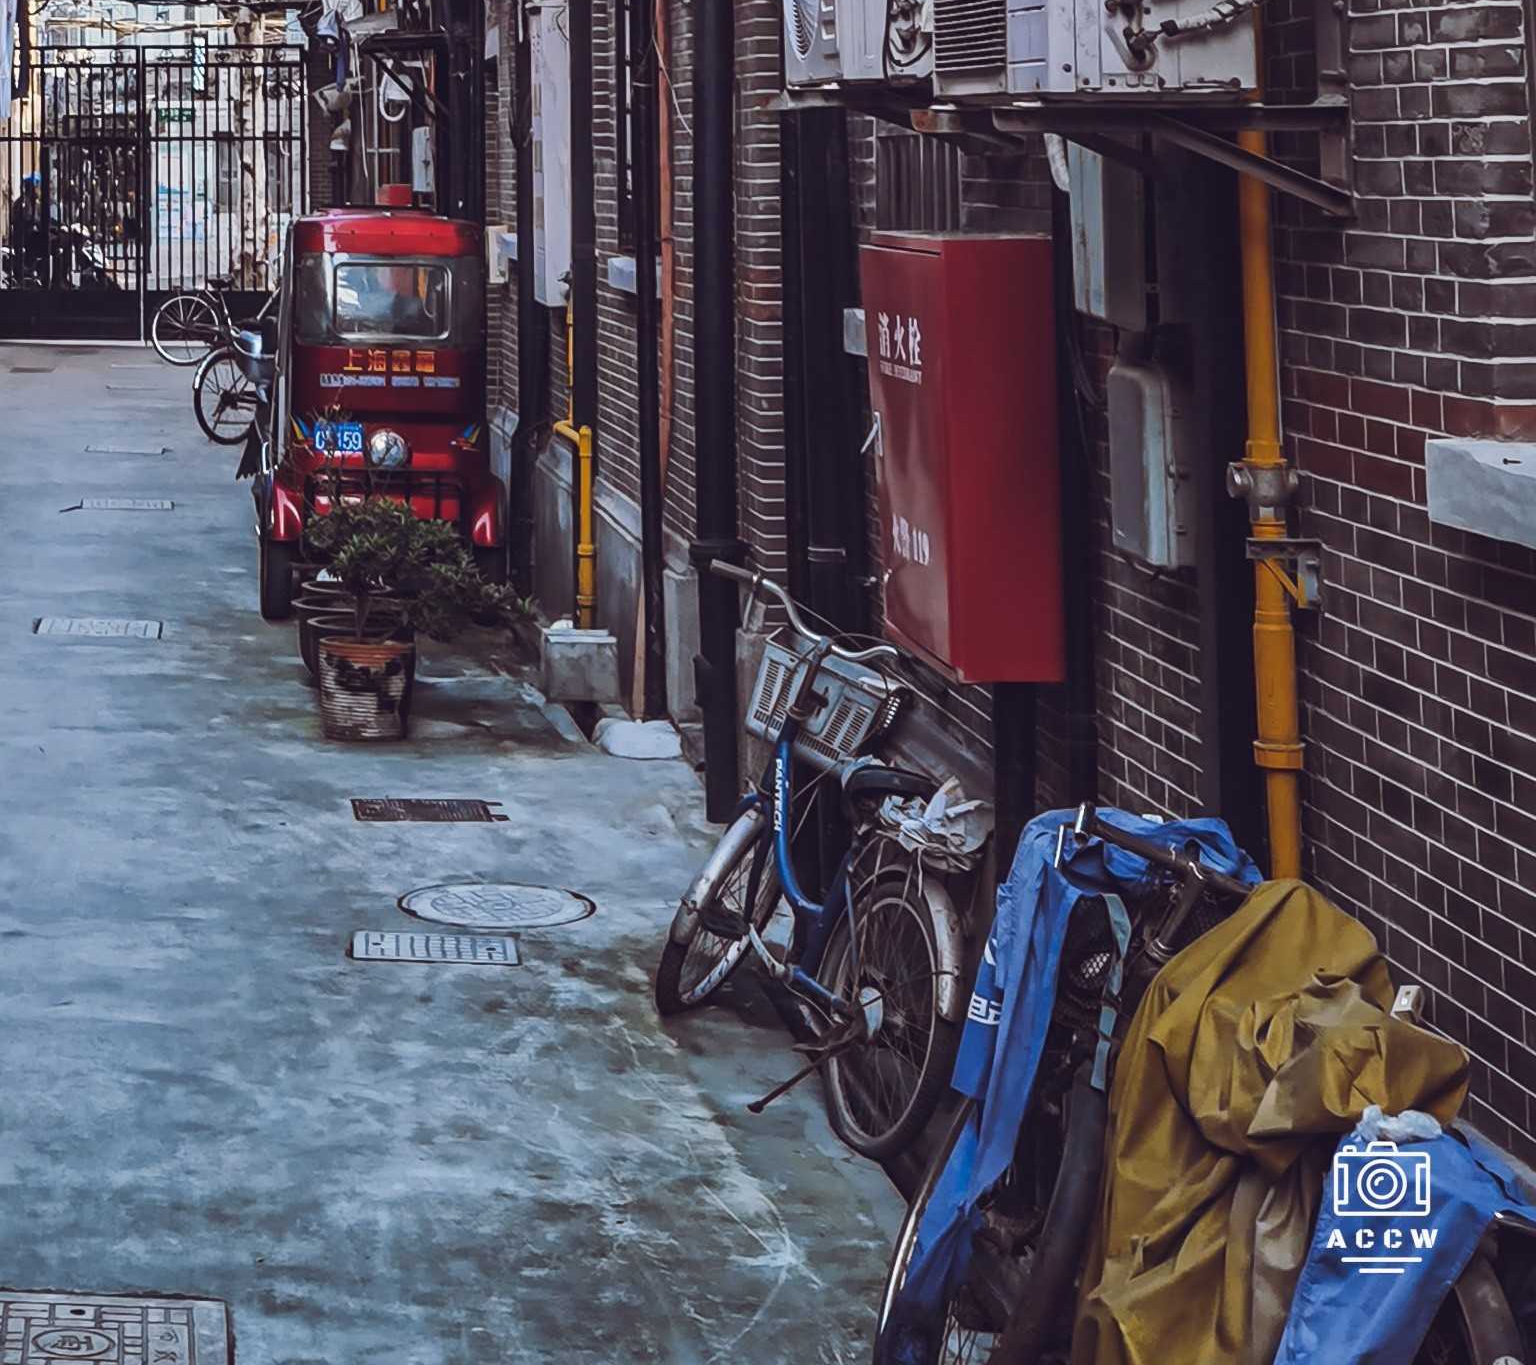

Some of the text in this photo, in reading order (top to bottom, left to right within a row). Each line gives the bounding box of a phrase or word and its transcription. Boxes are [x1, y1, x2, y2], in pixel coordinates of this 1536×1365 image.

[343, 348, 436, 373] 上海
[878, 311, 922, 366] 消火栓
[774, 758, 784, 832] PANTECH
